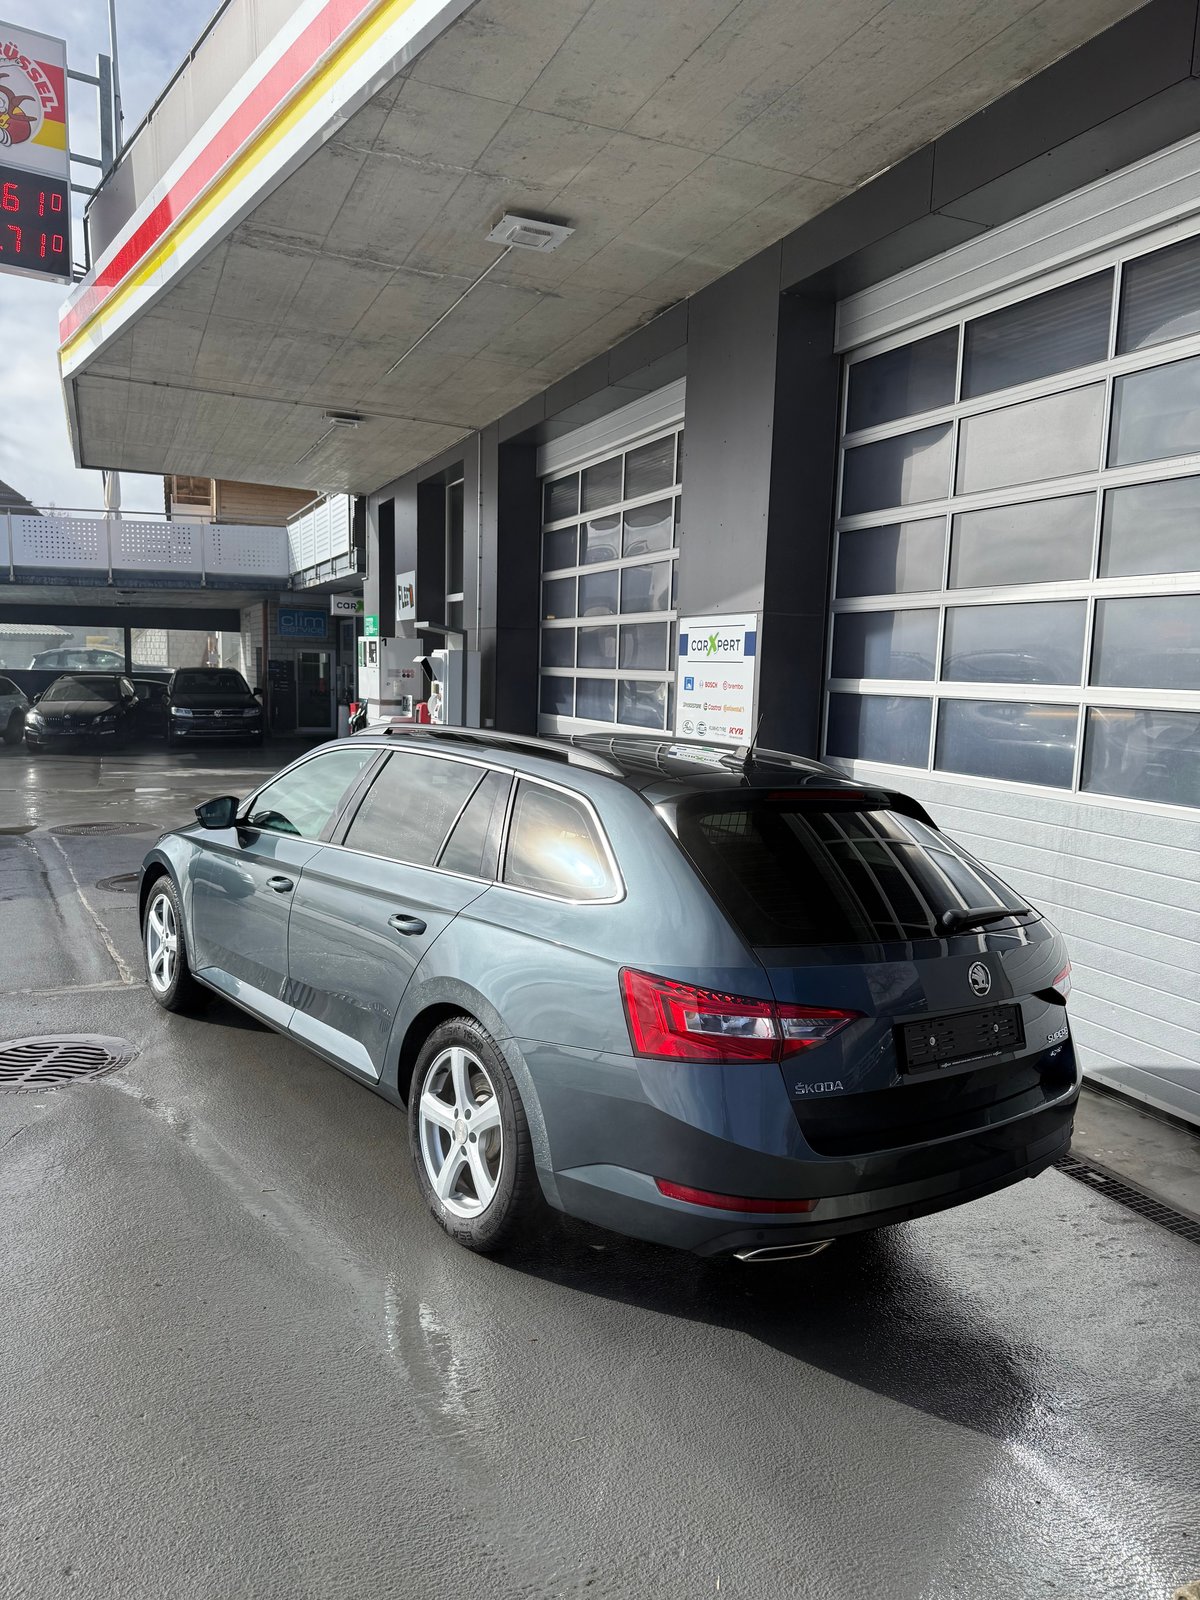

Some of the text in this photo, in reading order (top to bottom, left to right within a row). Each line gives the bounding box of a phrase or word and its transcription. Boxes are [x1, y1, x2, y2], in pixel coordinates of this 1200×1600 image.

[0, 41, 55, 108] ÜSSEL
[281, 612, 324, 627] clim
[382, 638, 388, 647] 1
[795, 1080, 844, 1095] ŠKODA
